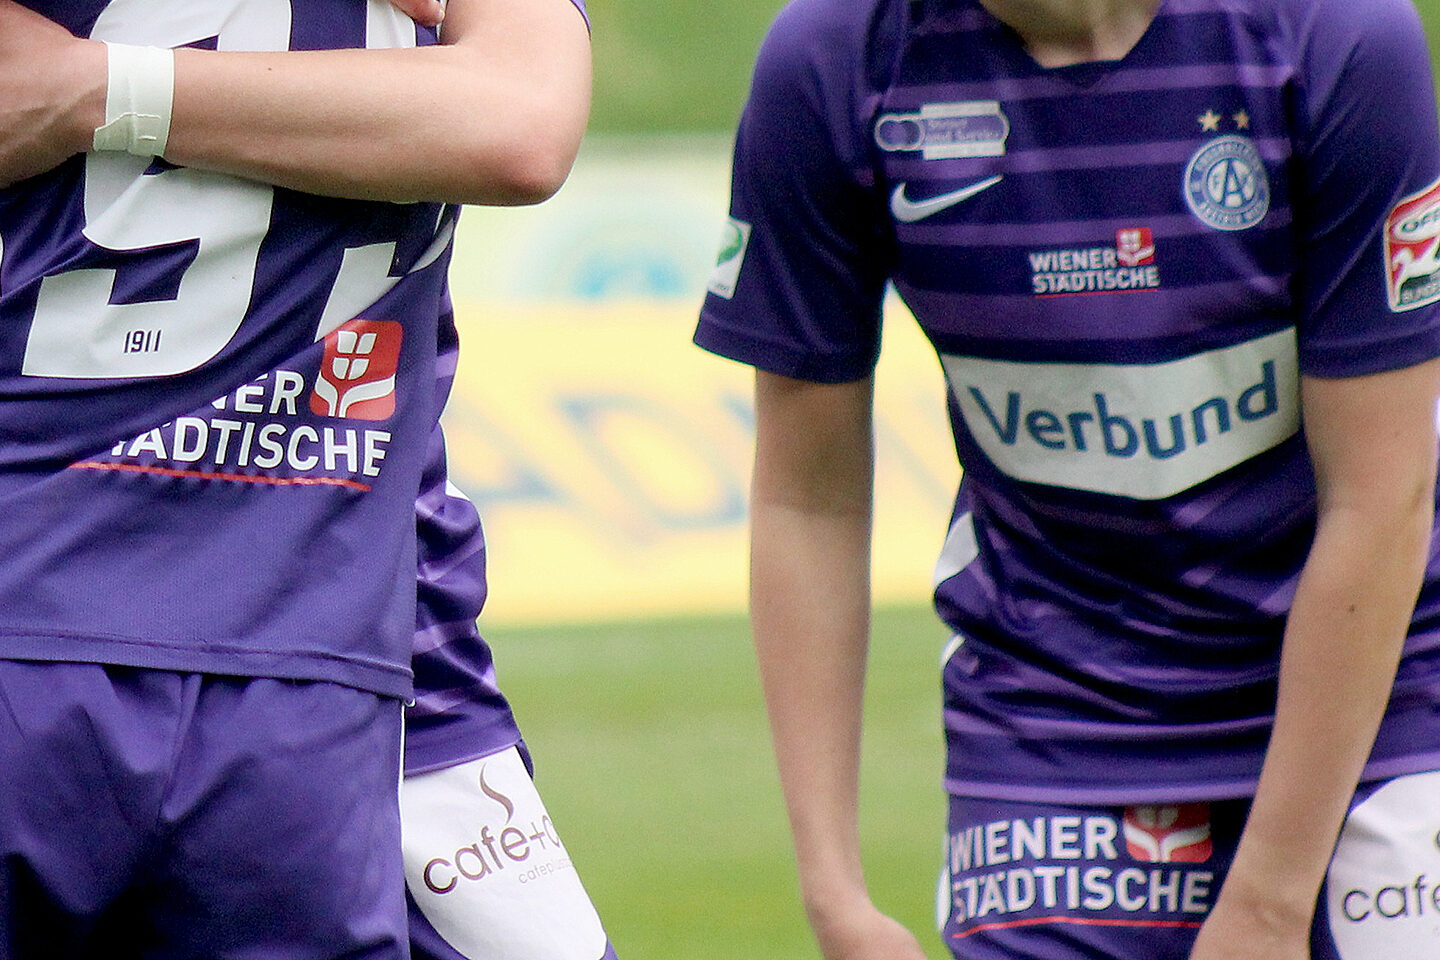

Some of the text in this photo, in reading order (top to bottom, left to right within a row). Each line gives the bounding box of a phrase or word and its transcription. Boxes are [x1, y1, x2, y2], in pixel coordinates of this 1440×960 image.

[1029, 247, 1117, 273] WIENER
[123, 329, 162, 354] 1911
[967, 359, 1279, 460] Verbund
[951, 815, 1119, 876] WIENER
[951, 865, 1214, 924] STÄDTISCHE
[1343, 873, 1440, 922] caf
